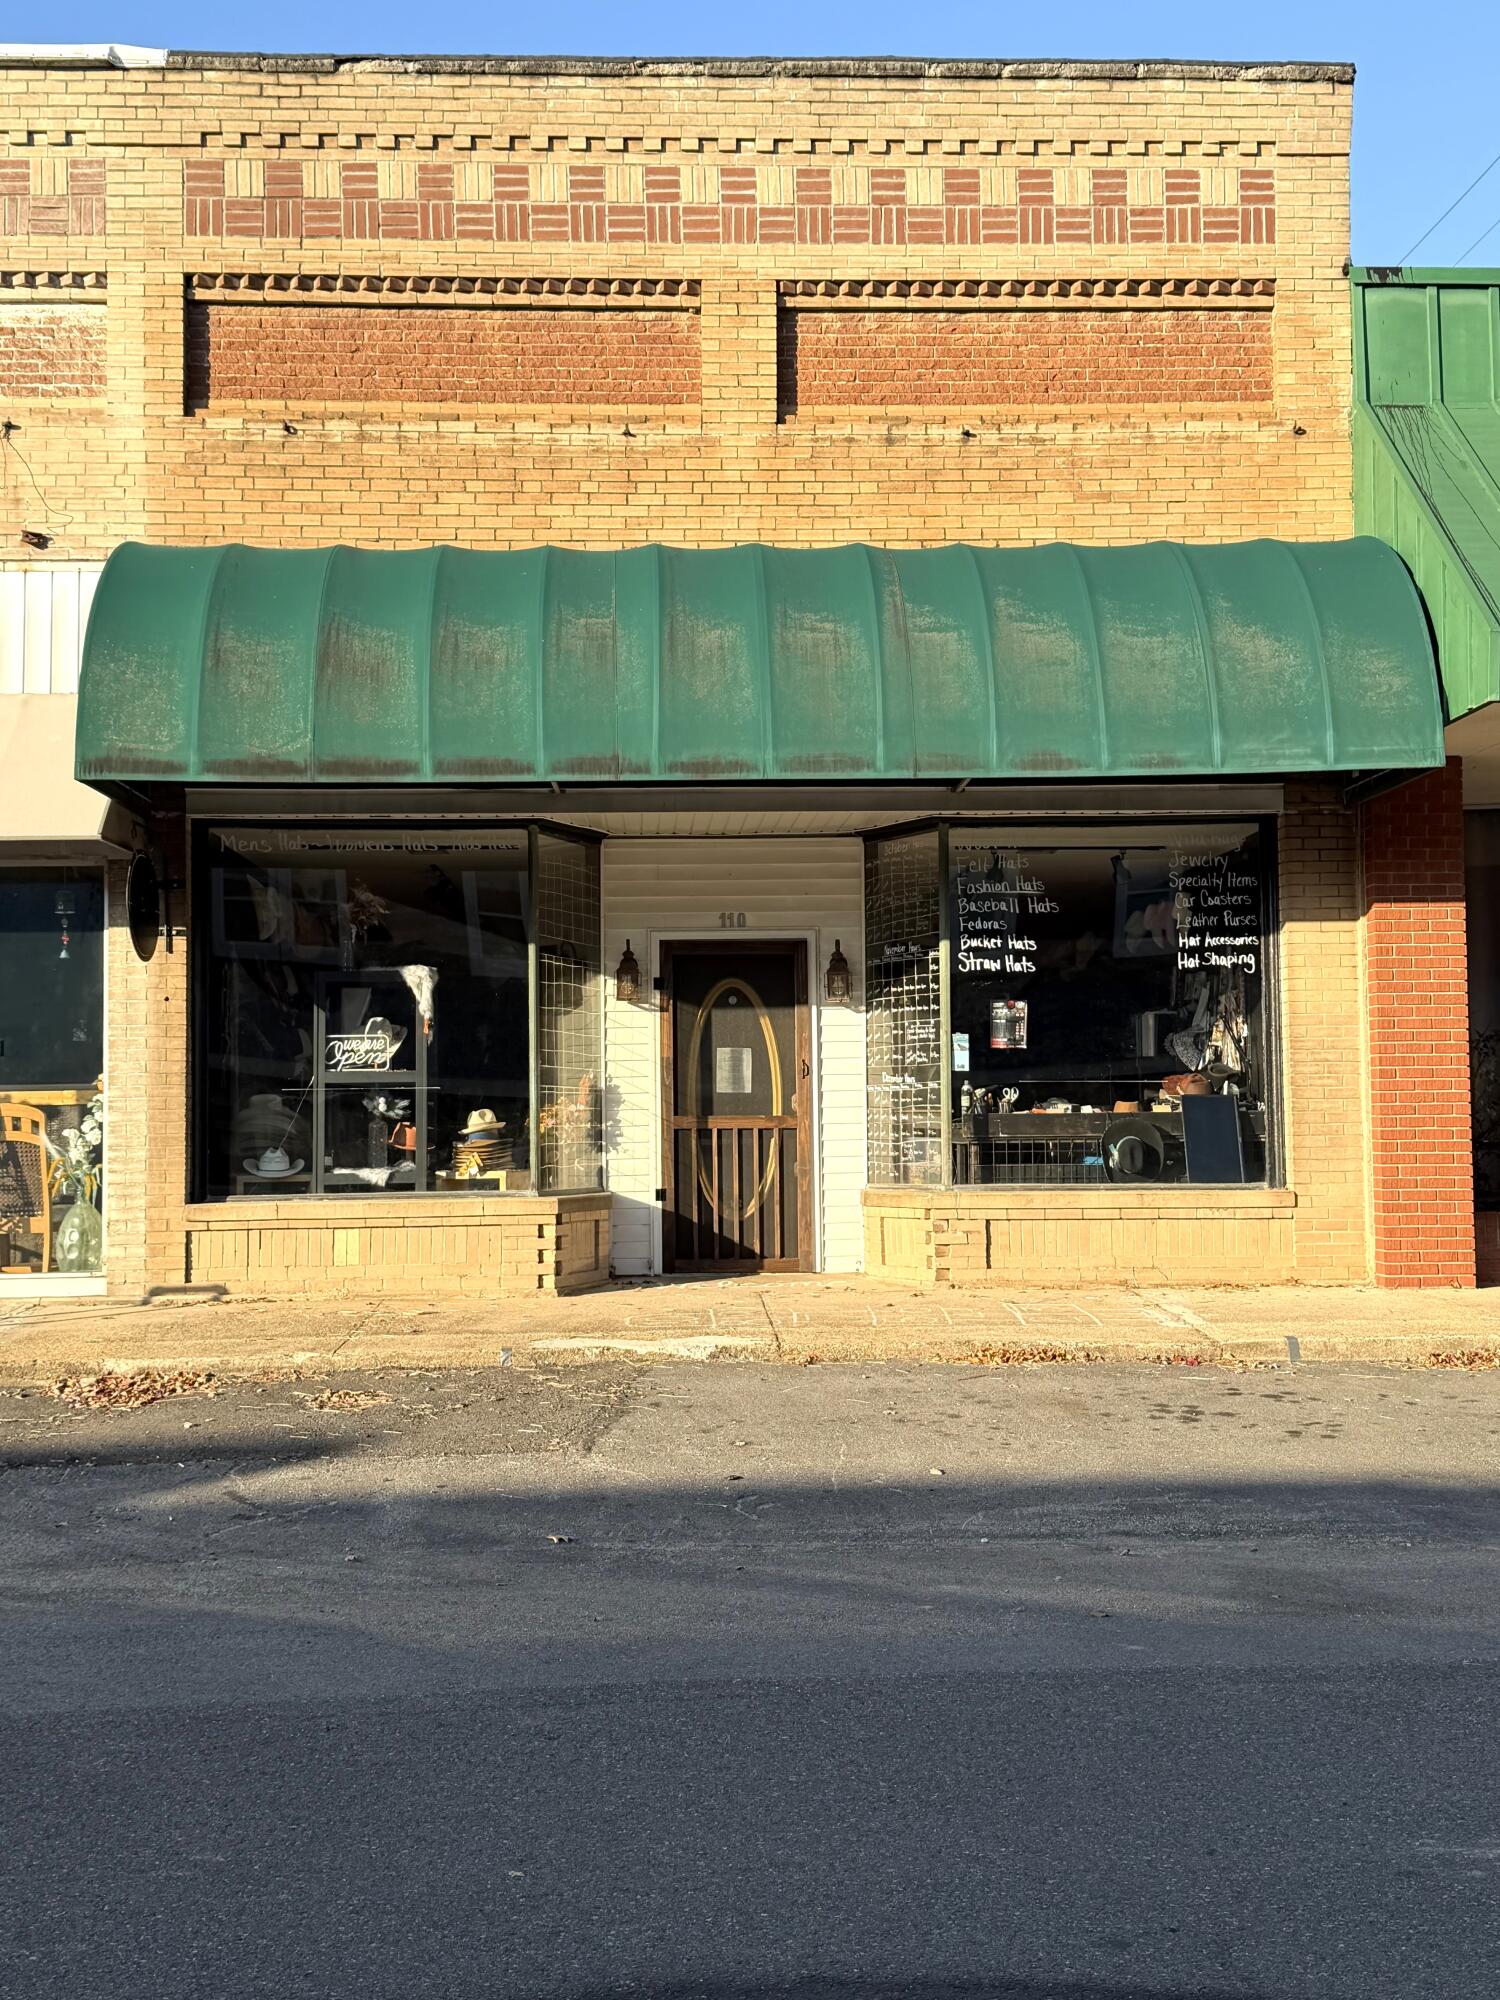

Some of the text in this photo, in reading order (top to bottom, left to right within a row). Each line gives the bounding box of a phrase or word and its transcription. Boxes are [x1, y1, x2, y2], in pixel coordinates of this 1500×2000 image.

[220, 833, 272, 852] Mens
[402, 833, 438, 852] Hats
[956, 856, 991, 873] Felt
[998, 853, 1030, 869] Hats
[1168, 850, 1228, 873] Jewelry
[957, 875, 1045, 894] Fashion Hats
[1169, 871, 1258, 892] Specialty Items
[958, 896, 1059, 914] Baseball Hats
[1175, 889, 1251, 908] Car Coasters
[718, 912, 746, 928] 110
[959, 916, 1007, 931] Fedoras
[1176, 910, 1257, 929] Leather Purses
[960, 933, 1037, 950] Bucket Hats
[1179, 931, 1259, 949] Hat Accessories
[958, 951, 1001, 972] Straw
[1005, 954, 1036, 972] Hats
[1178, 951, 1255, 974] Hat Shaping
[343, 1039, 361, 1051] we
[325, 1041, 388, 1072] Open
